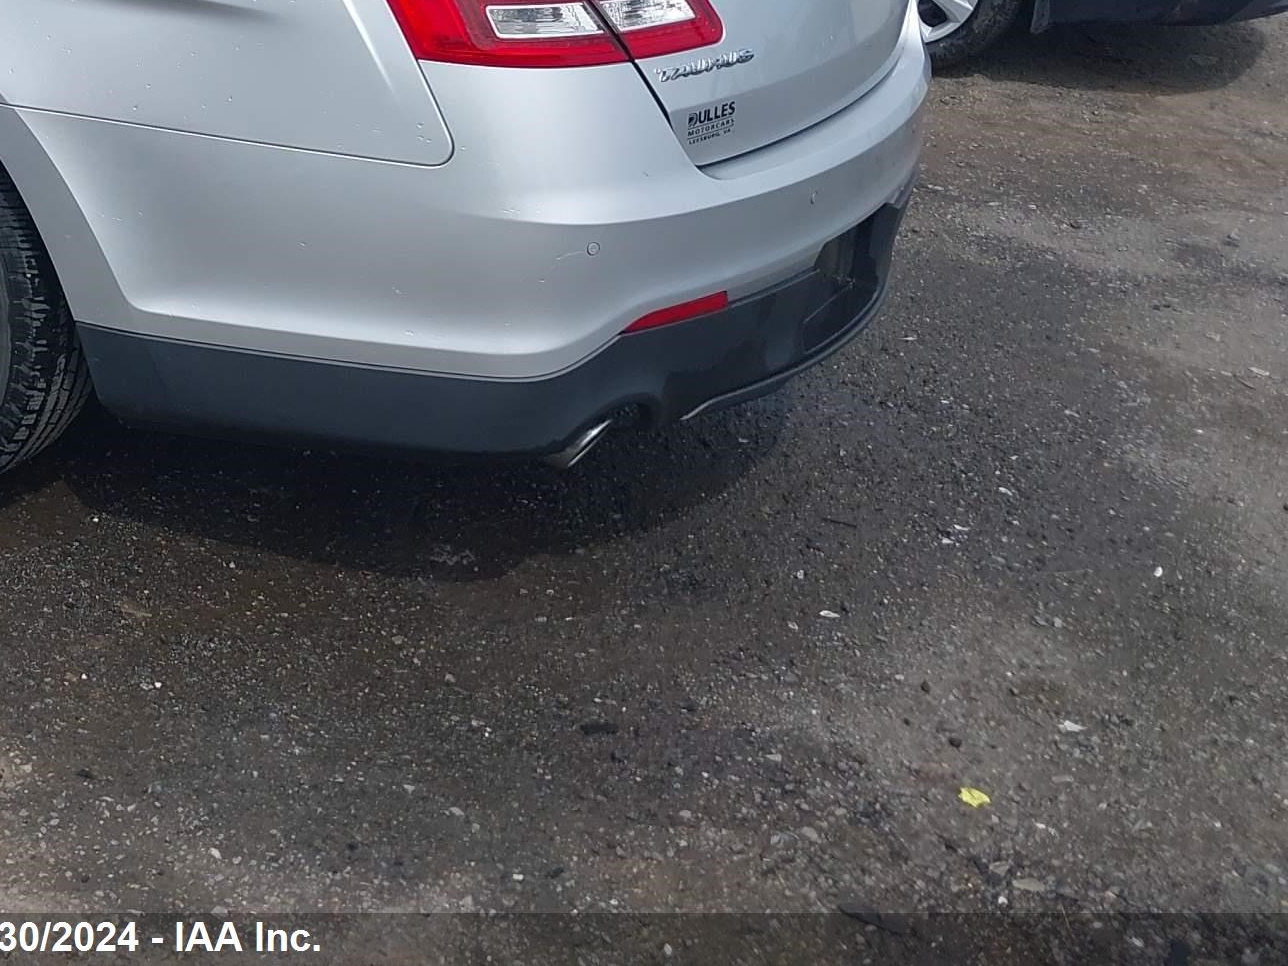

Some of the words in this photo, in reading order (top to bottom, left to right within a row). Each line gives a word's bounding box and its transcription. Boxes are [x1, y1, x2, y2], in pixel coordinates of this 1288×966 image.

[654, 49, 754, 82] TAURUS
[687, 117, 735, 137] MOTORCARS
[688, 101, 735, 127] DULLES
